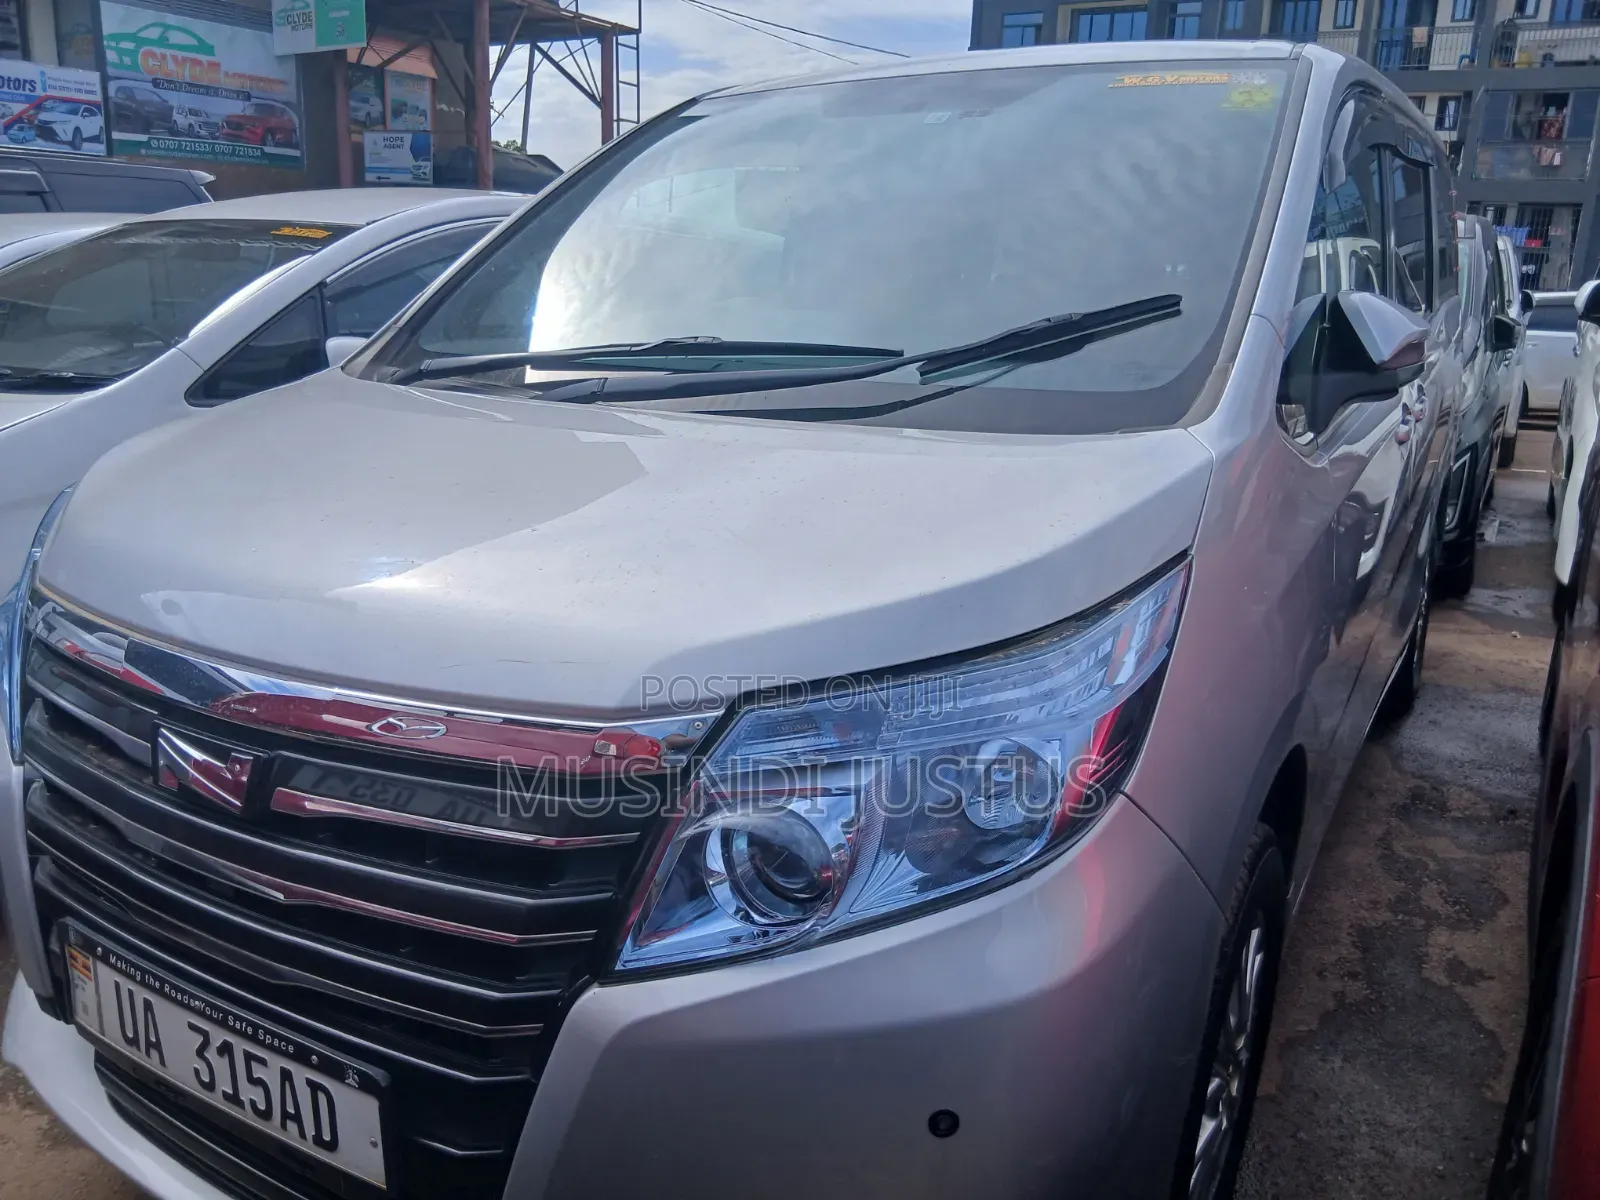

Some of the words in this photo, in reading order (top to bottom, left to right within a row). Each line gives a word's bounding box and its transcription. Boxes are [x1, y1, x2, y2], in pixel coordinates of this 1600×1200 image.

[286, 11, 313, 25] CLYDE
[291, 22, 313, 32] MOTORS
[140, 48, 222, 84] CLYDE
[182, 83, 206, 94] Dream
[218, 88, 238, 99] Drive
[160, 140, 178, 149] 0707
[215, 144, 233, 153] 0707
[109, 953, 141, 981] Making
[145, 972, 160, 989] the
[164, 983, 195, 1008] Roads
[199, 1000, 224, 1020] Your
[228, 1015, 253, 1035] Safe
[258, 1029, 294, 1053] Space
[113, 978, 167, 1067] UA
[187, 1020, 339, 1153] 315AD
